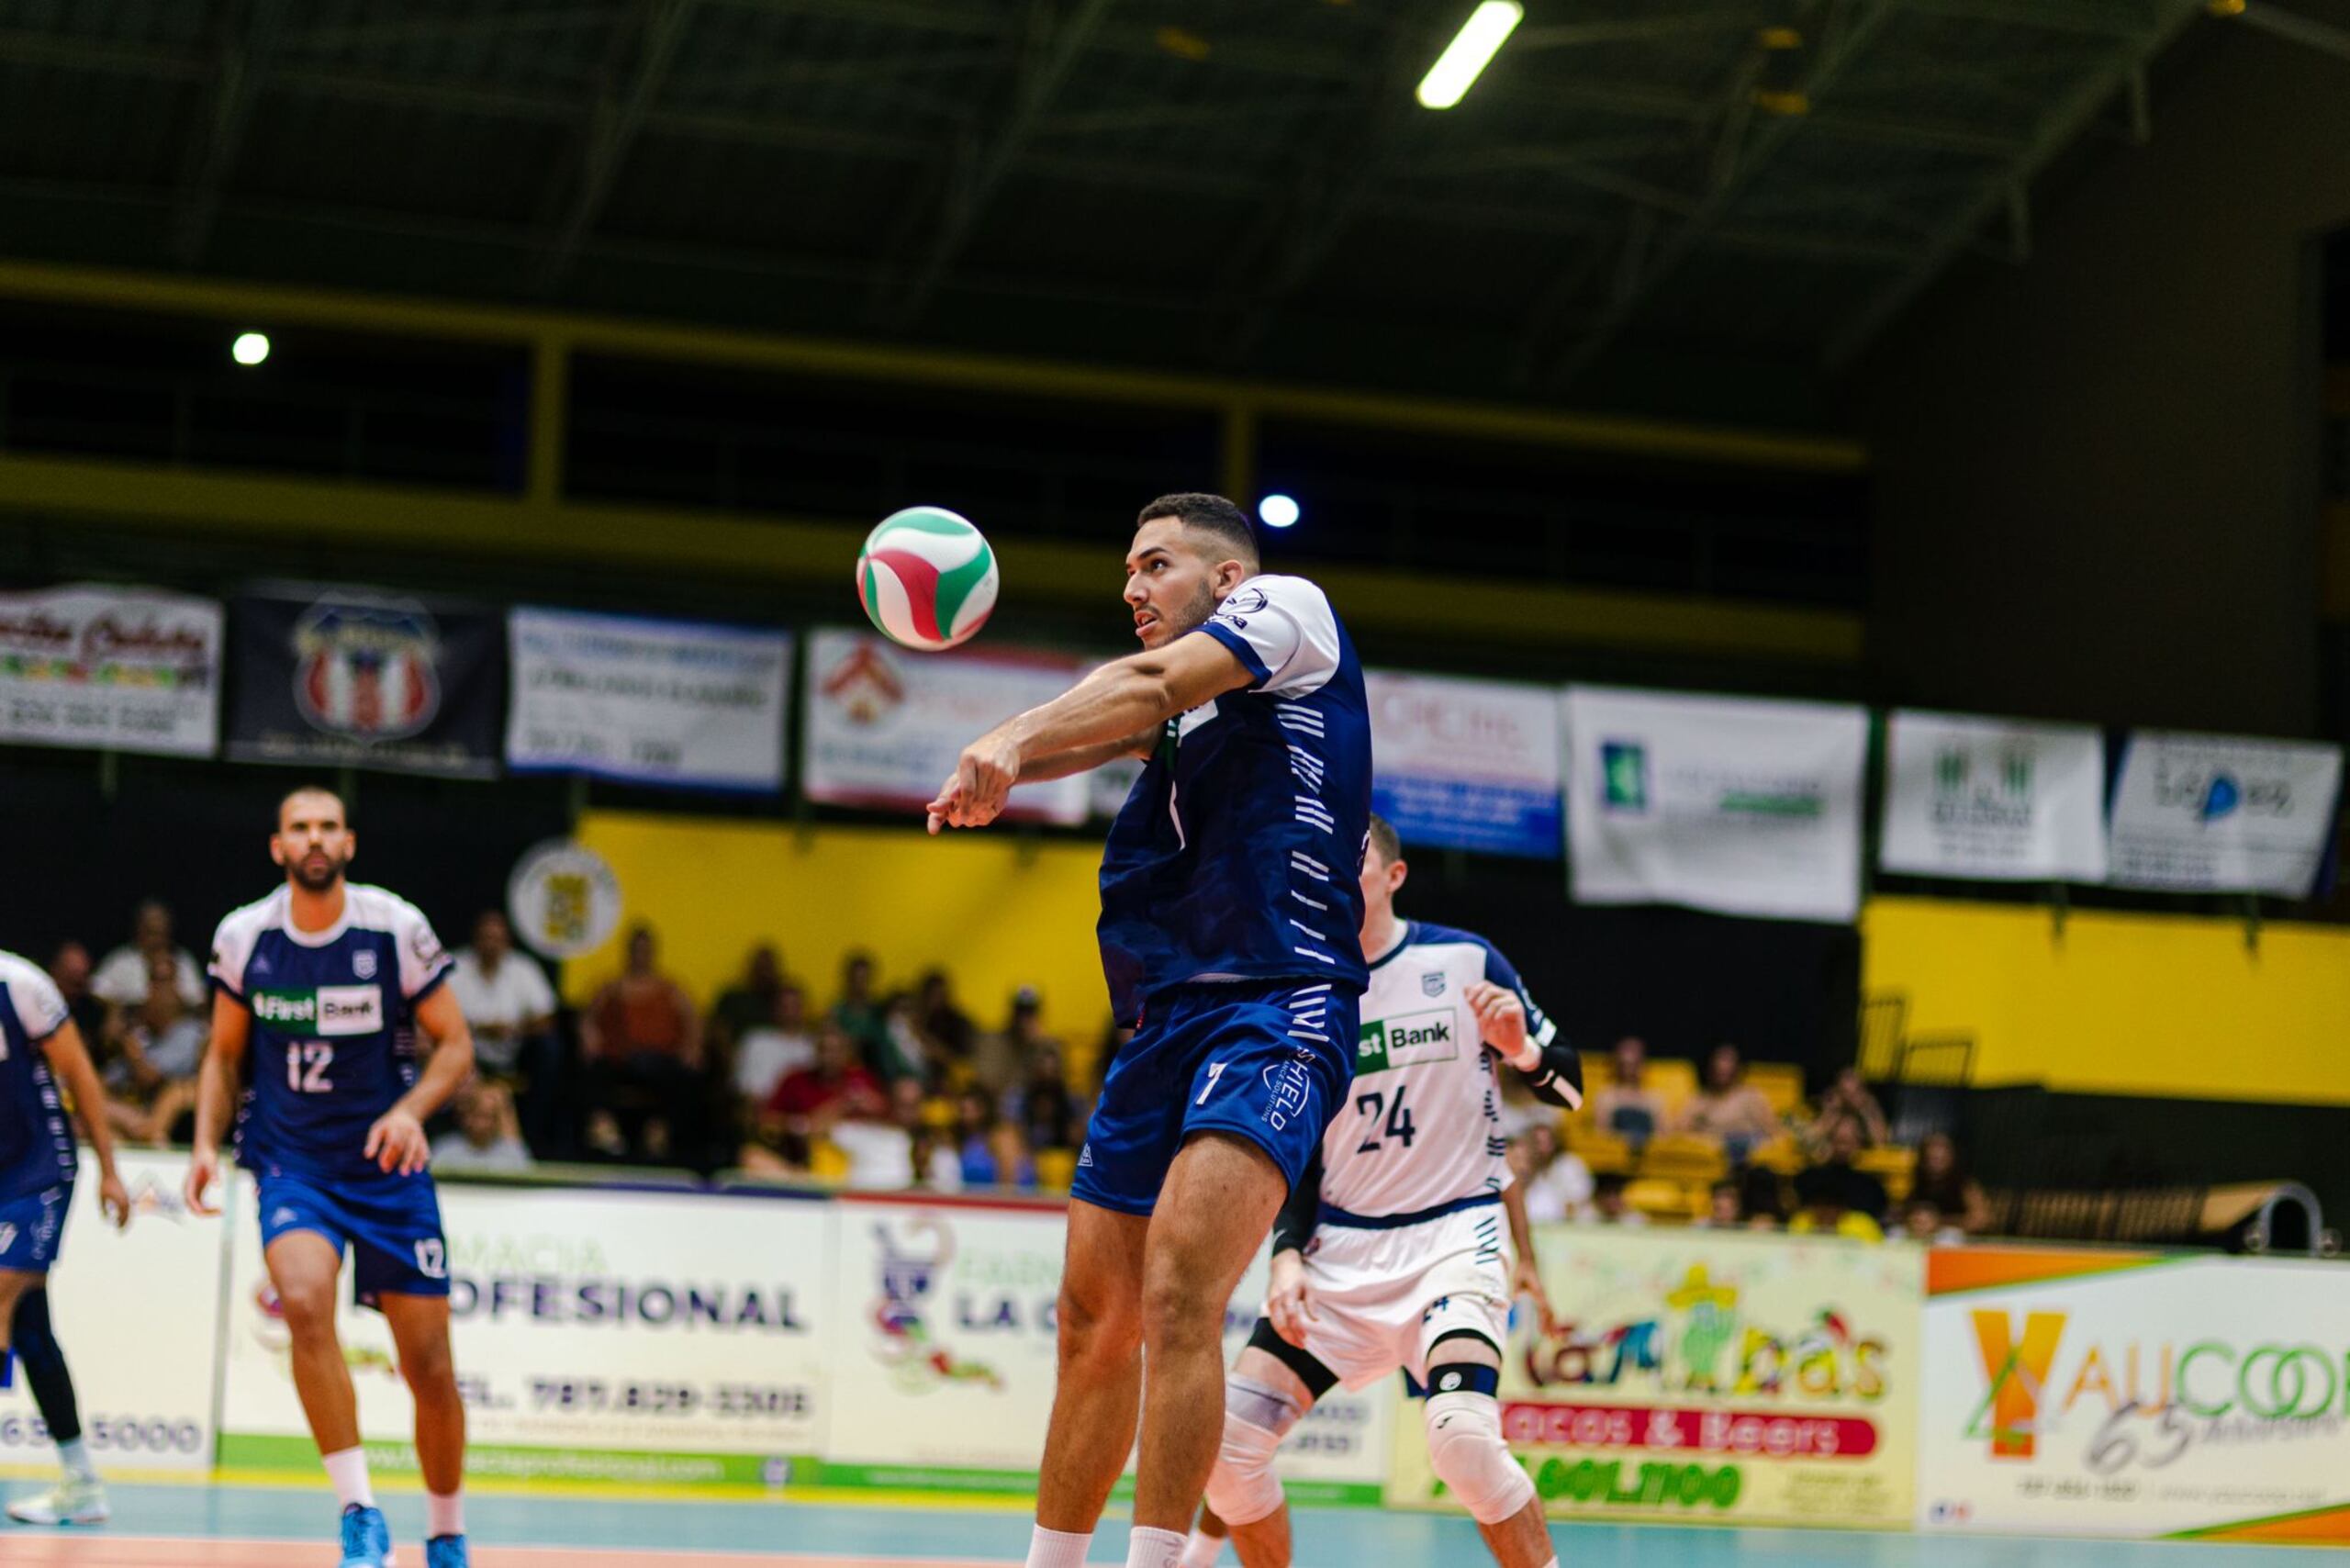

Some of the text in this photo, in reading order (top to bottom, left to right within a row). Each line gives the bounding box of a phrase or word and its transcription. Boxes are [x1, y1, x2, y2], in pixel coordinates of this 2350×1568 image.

[1391, 1022, 1449, 1049] Bank
[286, 1041, 334, 1092] 12
[1270, 1048, 1316, 1131] SHIELD
[1357, 1085, 1416, 1154] 24
[414, 1238, 447, 1279] 12
[453, 1234, 610, 1274] MACIA
[447, 1277, 808, 1334] OFESIONAL
[455, 1372, 514, 1409] EL.
[1967, 1307, 2350, 1462] YAUCOO
[1503, 1406, 1633, 1446] acos
[1643, 1409, 1686, 1449] &
[2084, 1398, 2193, 1476] 65
